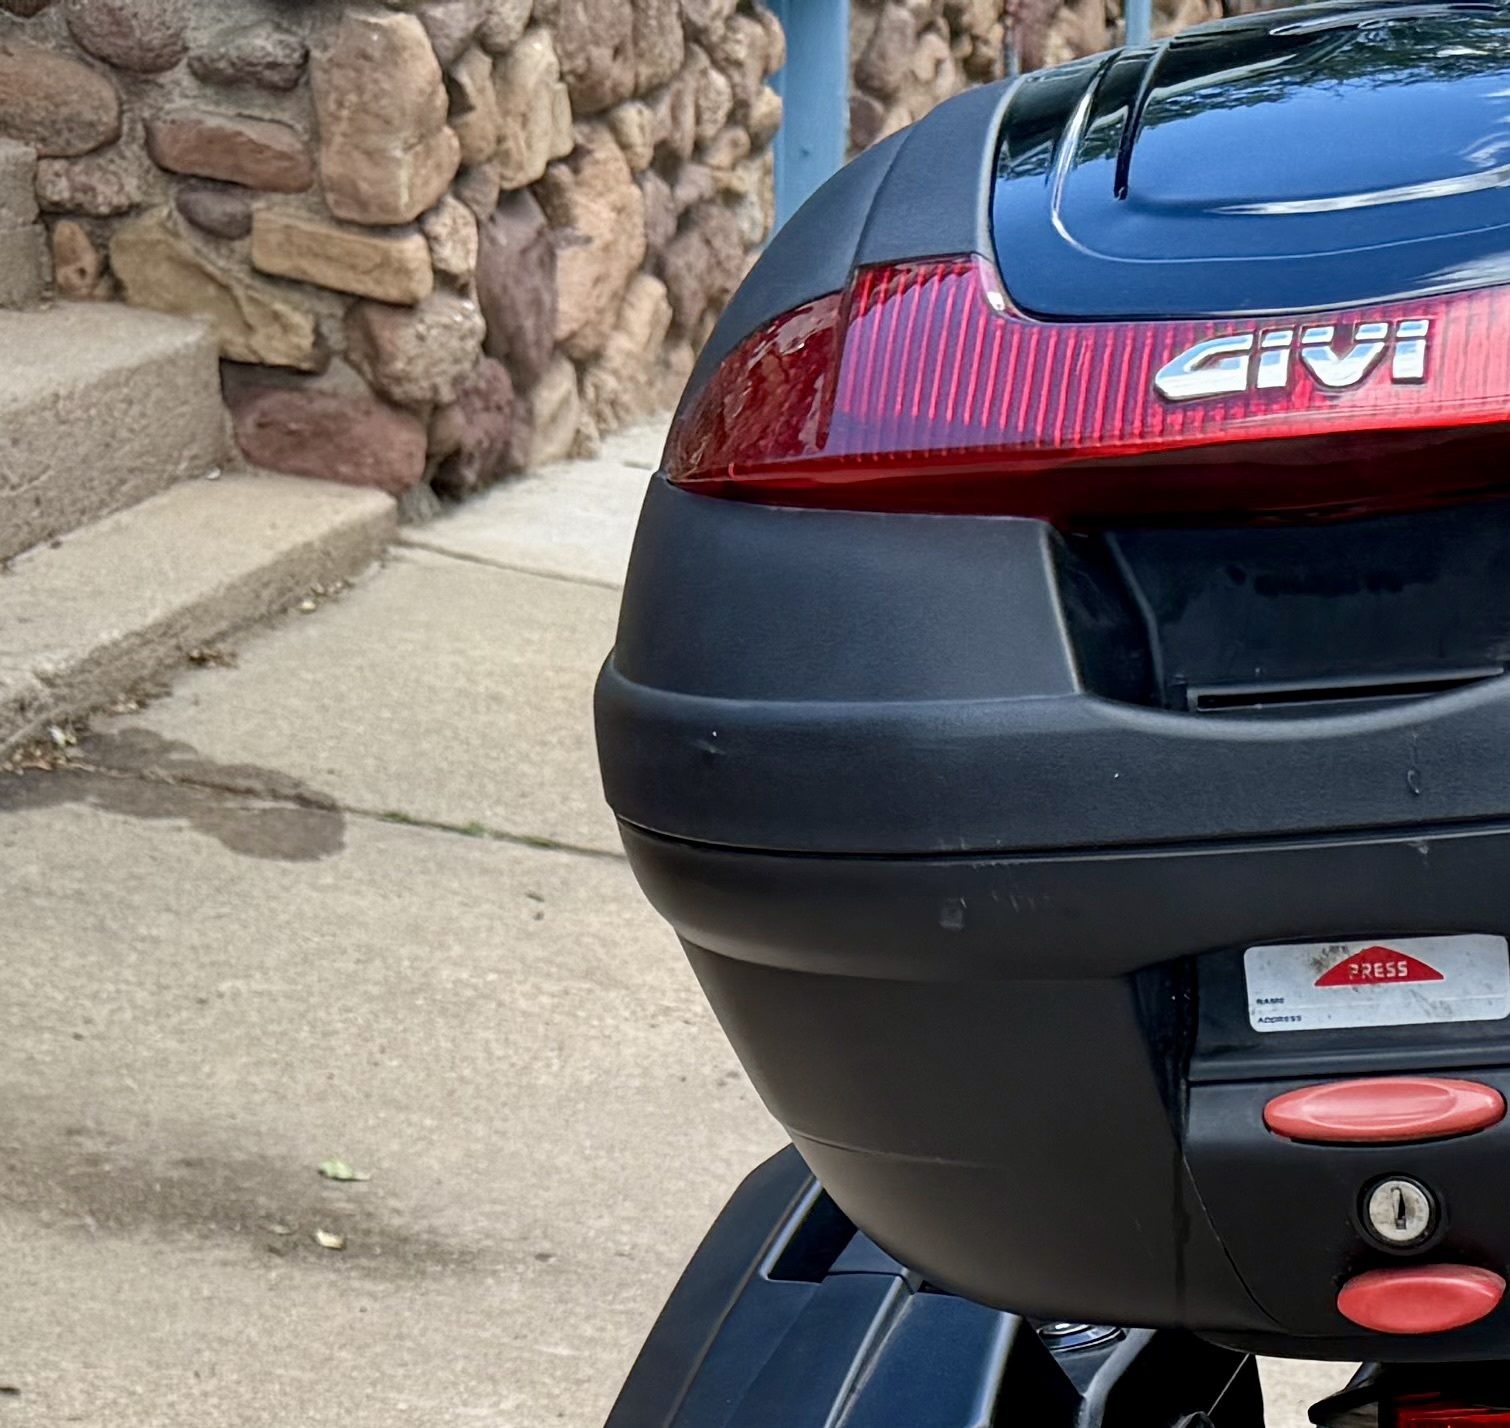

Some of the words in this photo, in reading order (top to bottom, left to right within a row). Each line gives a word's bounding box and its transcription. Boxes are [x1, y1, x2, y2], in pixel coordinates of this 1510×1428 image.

[1153, 319, 1431, 400] GIVI
[1348, 960, 1408, 981] PRESS
[1257, 1015, 1302, 1023] ADDRESS
